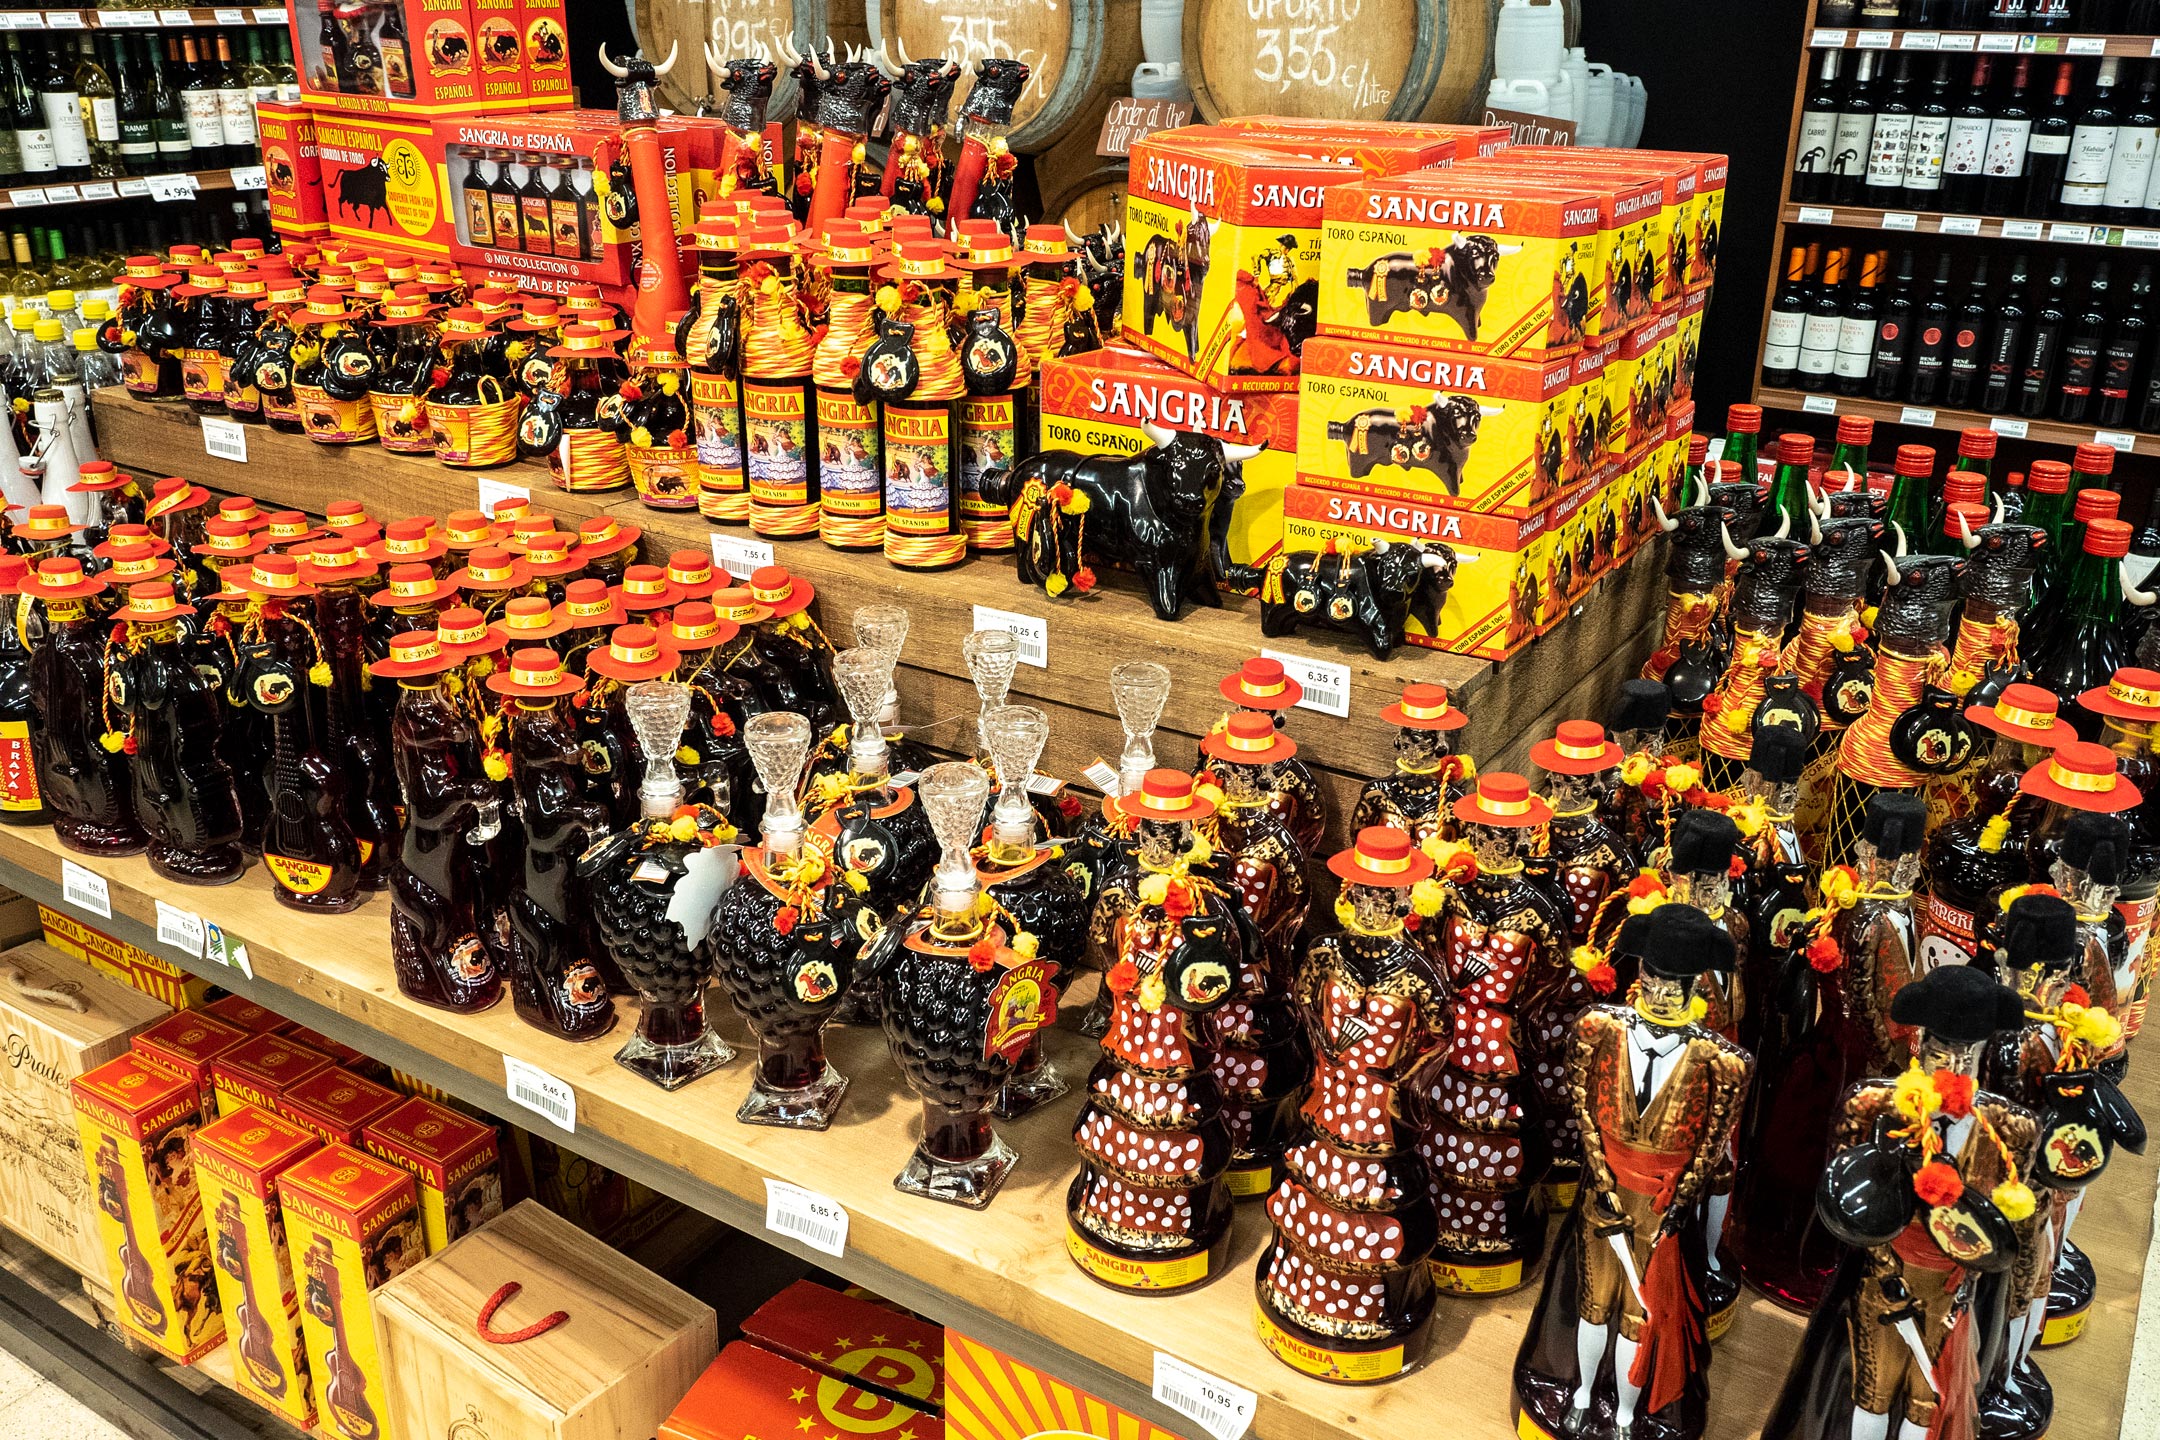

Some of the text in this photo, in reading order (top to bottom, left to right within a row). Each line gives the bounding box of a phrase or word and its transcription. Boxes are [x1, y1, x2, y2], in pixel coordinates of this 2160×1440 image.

[434, 83, 474, 100] ESPAÑOLA
[485, 80, 522, 95] ESPAÑOLA
[532, 76, 568, 92] ESPAÑOLA
[1108, 98, 1185, 128] Order at the
[124, 124, 149, 133] RAIMAT
[347, 130, 383, 151] ESPAÑOLA
[459, 128, 574, 152] SANGRIA DE ESPAÑA
[1148, 156, 1216, 207] SANGRIA
[1676, 174, 1696, 195] SANGRIA
[1704, 163, 1727, 184] SANGRIA
[664, 146, 682, 233] COLLECTION
[1251, 184, 1324, 209] SANGR
[1640, 189, 1662, 209] ANGRIA
[1129, 206, 1169, 232] TORO ESPAÑOL
[1366, 194, 1505, 229] SANGRIA
[1563, 207, 1598, 226] SANGRIA
[1614, 197, 1641, 218] SANGRIA
[1326, 228, 1408, 246] TORO ESPAÑOL
[494, 254, 568, 274] MIX COLLECTION
[1658, 312, 1678, 332] SANGRIA
[1494, 342, 1510, 356] TORO
[1507, 320, 1534, 345] ESPAÑOL
[1636, 326, 1658, 349] SANGRIA
[1349, 352, 1488, 390] SANGRIA
[1577, 350, 1604, 374] SANGRIA
[1242, 380, 1294, 392] RECUERDO DE
[1544, 366, 1570, 390] SANGRIA
[694, 382, 732, 400] GRIA
[1307, 381, 1389, 402] TORO ESPAÑOL
[1090, 378, 1248, 435] SANGRIA
[1674, 410, 1694, 432] SANGRIA
[1048, 424, 1081, 443] TORO
[629, 448, 698, 460] SANGRIA
[762, 490, 788, 498] SPANISH
[1341, 480, 1361, 491] ESPAÑA
[1412, 492, 1433, 502] ESPAÑA
[1476, 469, 1530, 513] TORO ESPAÑOL 10cl.
[834, 499, 861, 508] SPANISH
[1556, 495, 1579, 520] SANGRIA
[902, 519, 930, 528] SPANISH
[1288, 522, 1316, 538] TORO
[1328, 497, 1463, 540] SANGRIA
[1518, 512, 1545, 540] SANGRIA
[743, 550, 767, 562] 7,55 €
[1008, 625, 1040, 640] 10,25 €
[1454, 641, 1469, 654] TORO
[1468, 624, 1492, 644] ESPAÑOL
[1308, 670, 1340, 687] 6,35 €
[8, 740, 21, 790] BRAVA
[274, 858, 322, 876] SANGRIA
[40, 908, 80, 940] SANGRIA
[1929, 896, 1975, 932] SANGRÍ
[84, 932, 126, 964] SANGRIA
[126, 944, 172, 974] SANGRIA
[995, 965, 1045, 1004] SANGRIA
[7, 1033, 70, 1090] Prades
[214, 1072, 278, 1111] SANGRIA
[542, 1082, 567, 1101] 8,45 €
[74, 1092, 133, 1137] SANGRIA
[142, 1096, 194, 1136] SANGRIA
[193, 1147, 258, 1195] SANGRIA
[366, 1140, 438, 1188] SANGRIA
[448, 1146, 494, 1186] SANGRIA
[306, 1176, 348, 1197] EUROBODEGAS
[38, 1203, 80, 1234] TORRES
[281, 1190, 353, 1238] SANGRIA
[362, 1193, 412, 1236] SANGRIA
[810, 1204, 840, 1222] 6,85 €
[1086, 1247, 1146, 1276] SANGRIA
[1272, 1328, 1335, 1365] SANGRIA
[1200, 1386, 1245, 1416] 10,95 €
